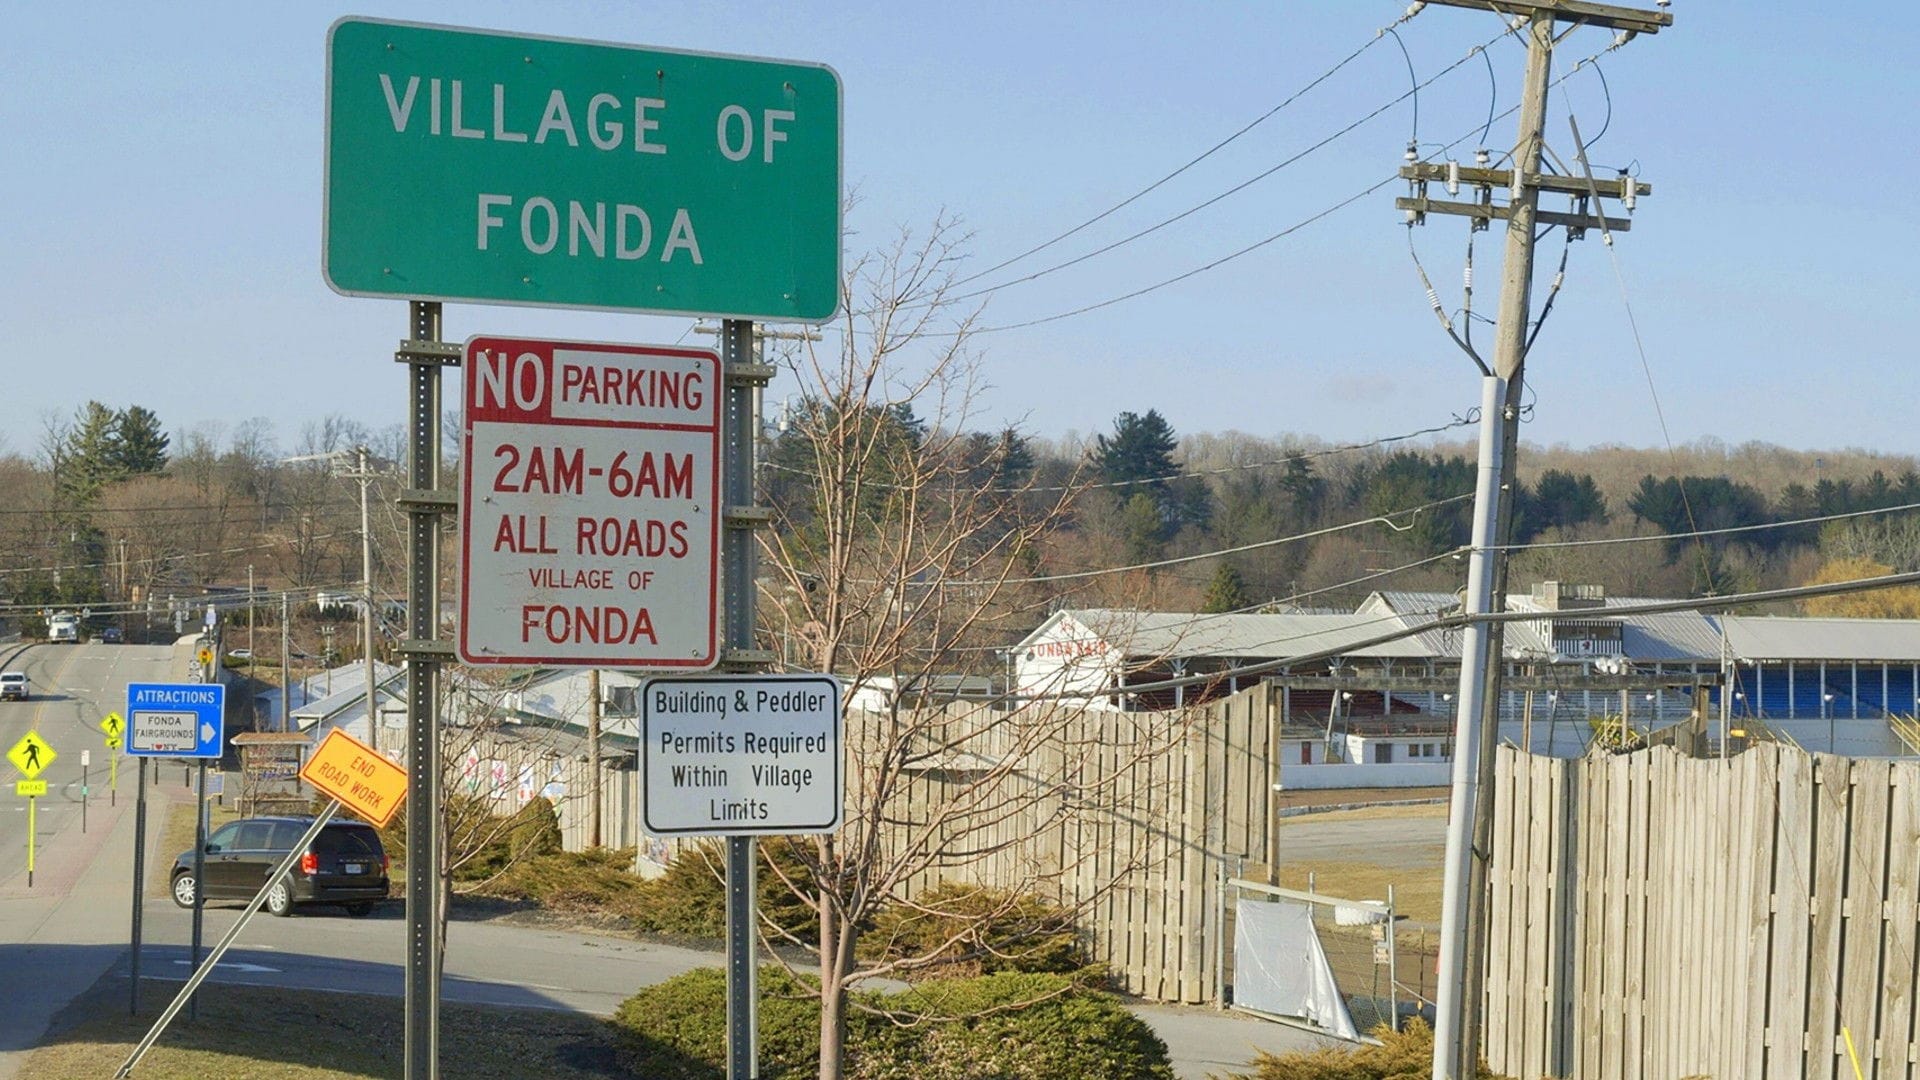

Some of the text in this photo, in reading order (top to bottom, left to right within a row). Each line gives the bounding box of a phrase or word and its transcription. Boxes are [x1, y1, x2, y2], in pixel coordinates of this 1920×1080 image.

[379, 74, 796, 163] VILLAGE OF
[477, 193, 703, 264] FONDA
[475, 352, 702, 411] NO PARKING
[494, 444, 693, 499] 2AM-6AM
[494, 514, 688, 558] ALL ROADS
[529, 568, 654, 590] VILLAGE OF
[521, 605, 658, 645] FONDA
[136, 690, 215, 704] ATTRACTIONS
[655, 690, 826, 720] Building & Peddler
[135, 729, 194, 739] FAIRGROUNDS
[148, 716, 181, 725] FONDA
[661, 731, 826, 759] Permits Required
[350, 756, 376, 778] END
[672, 764, 812, 793] Within Village
[318, 762, 384, 808] ROAD WORK
[711, 798, 768, 821] Limits
